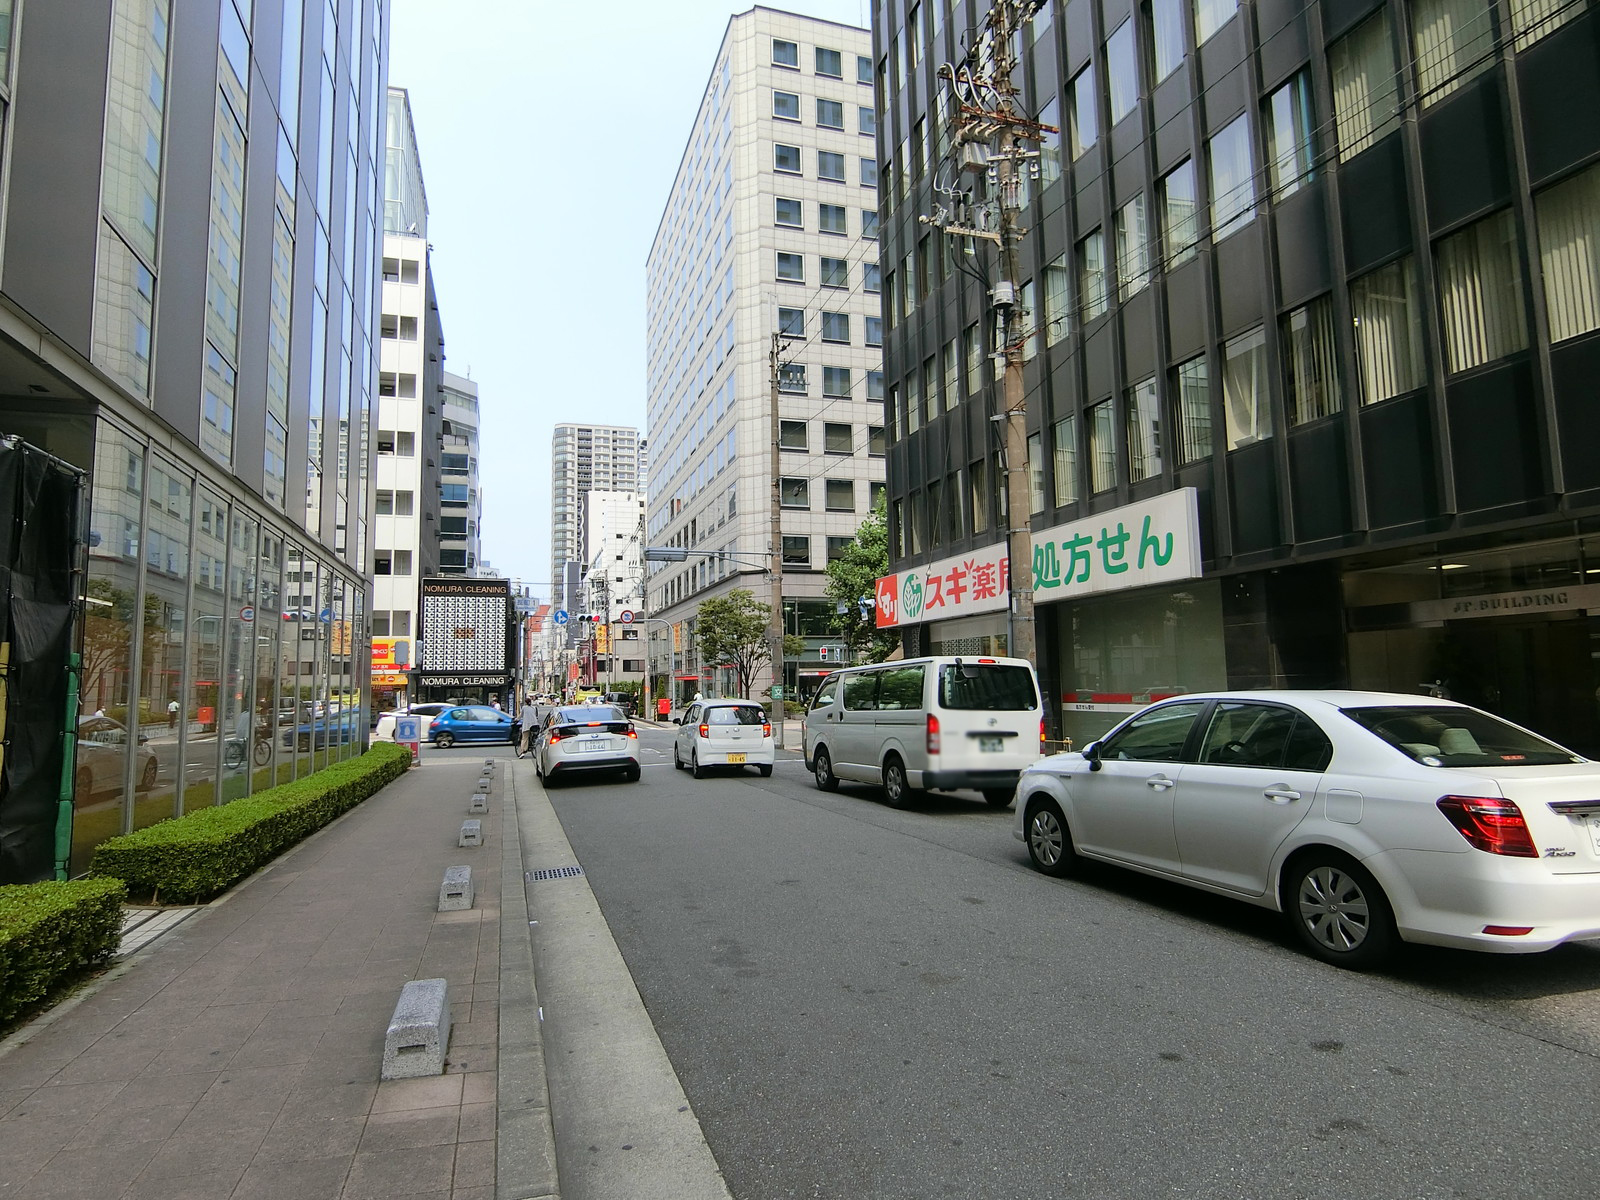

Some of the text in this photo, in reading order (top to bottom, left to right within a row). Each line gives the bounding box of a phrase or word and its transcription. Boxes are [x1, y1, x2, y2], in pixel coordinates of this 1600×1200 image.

[1032, 515, 1173, 591] 処方せん
[424, 585, 463, 593] NOMURA
[422, 677, 505, 685] NOMURA CLEANING
